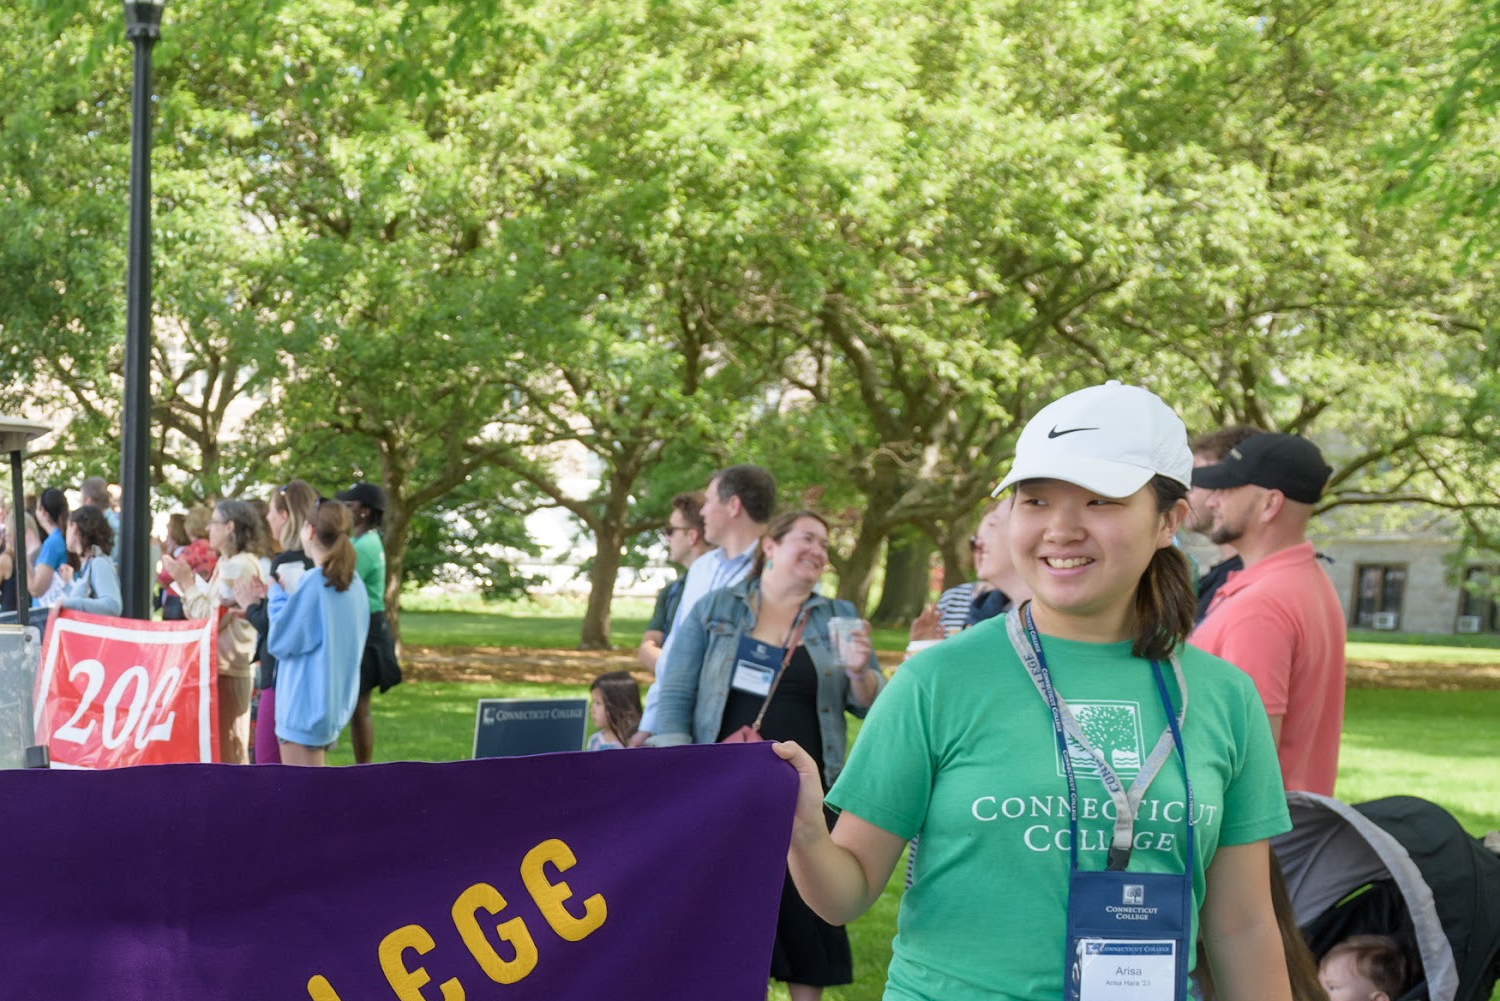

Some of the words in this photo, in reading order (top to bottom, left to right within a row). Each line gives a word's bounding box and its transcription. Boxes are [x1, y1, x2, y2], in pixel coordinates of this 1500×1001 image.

[1024, 825, 1175, 852] COLLGE
[1105, 905, 1158, 914] CONNECTICUT
[1115, 966, 1142, 976] Arisa
